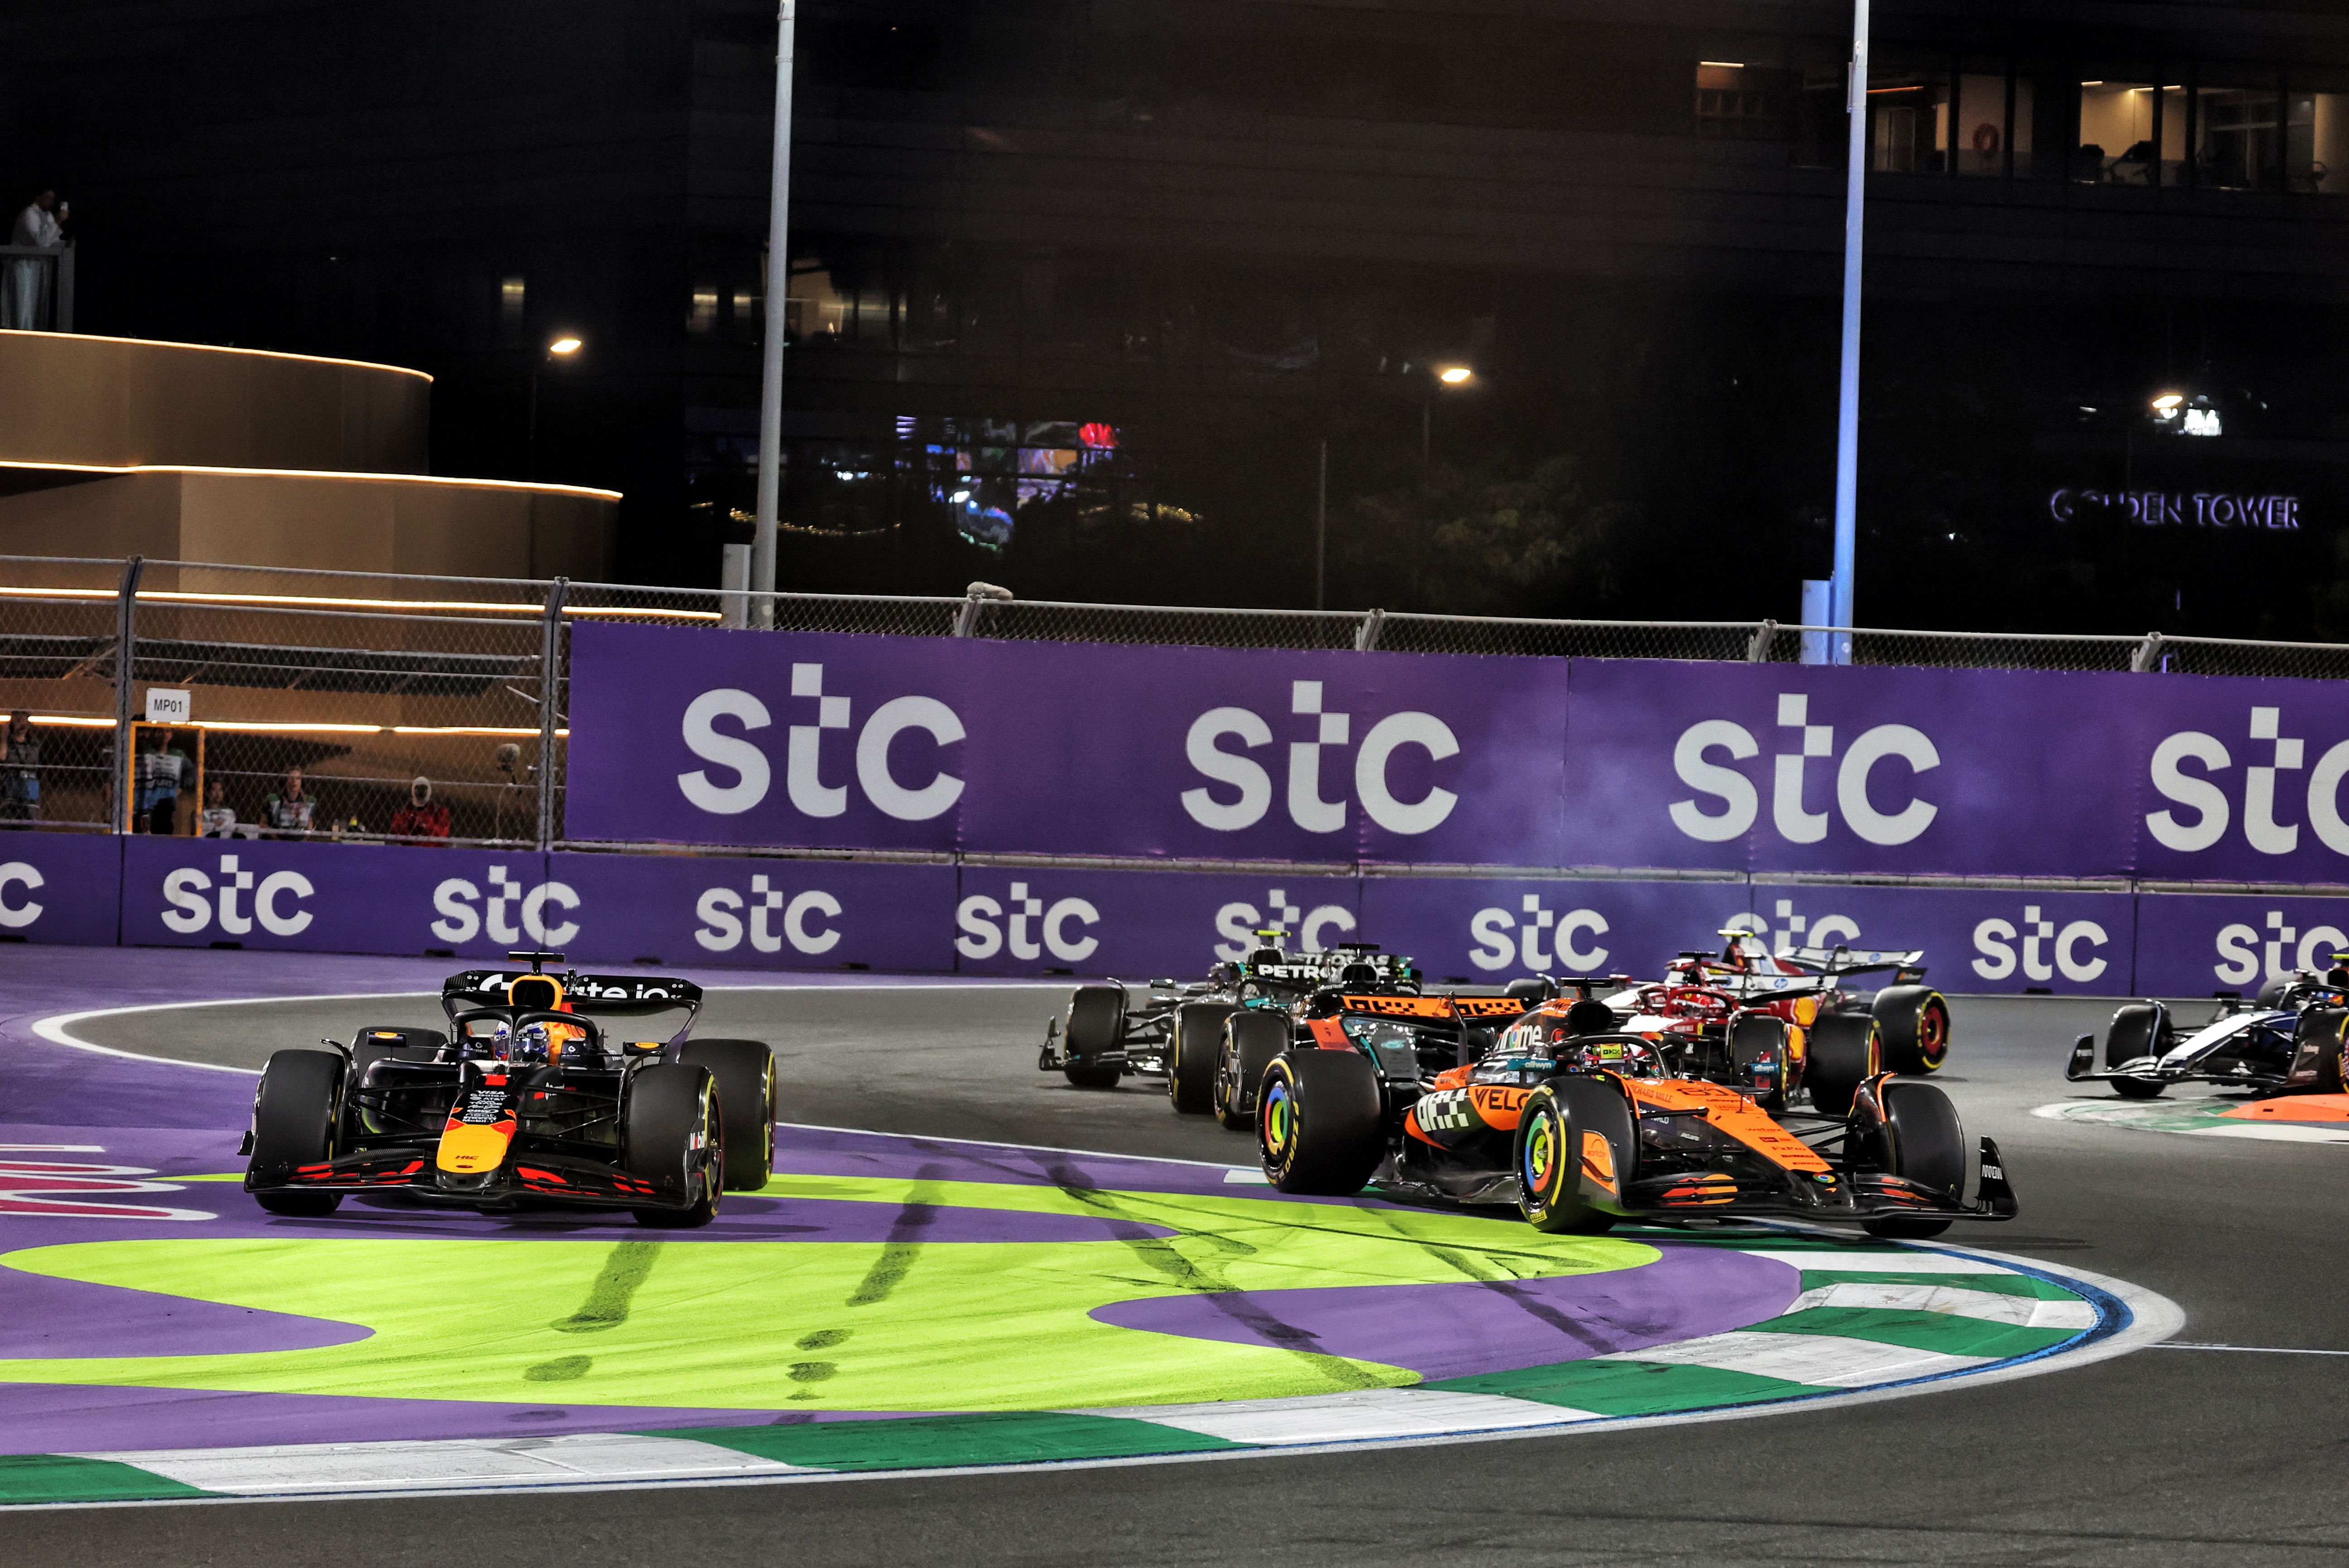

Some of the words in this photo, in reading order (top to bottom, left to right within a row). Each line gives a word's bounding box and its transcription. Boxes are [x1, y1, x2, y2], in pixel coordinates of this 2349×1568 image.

[2193, 493, 2299, 529] TOWER
[154, 699, 182, 713] MP01
[678, 663, 966, 821] stc
[1182, 680, 1460, 835] stc
[1669, 693, 1940, 846] stc
[161, 854, 314, 938] stc
[430, 865, 580, 951] stc
[694, 874, 847, 955] stc
[957, 882, 1100, 961] stc
[1469, 893, 1609, 972] stc
[1972, 905, 2108, 982] stc
[1349, 999, 1418, 1015] OKX
[1525, 1061, 1552, 1070] allwyn
[690, 1130, 705, 1151] Mobil
